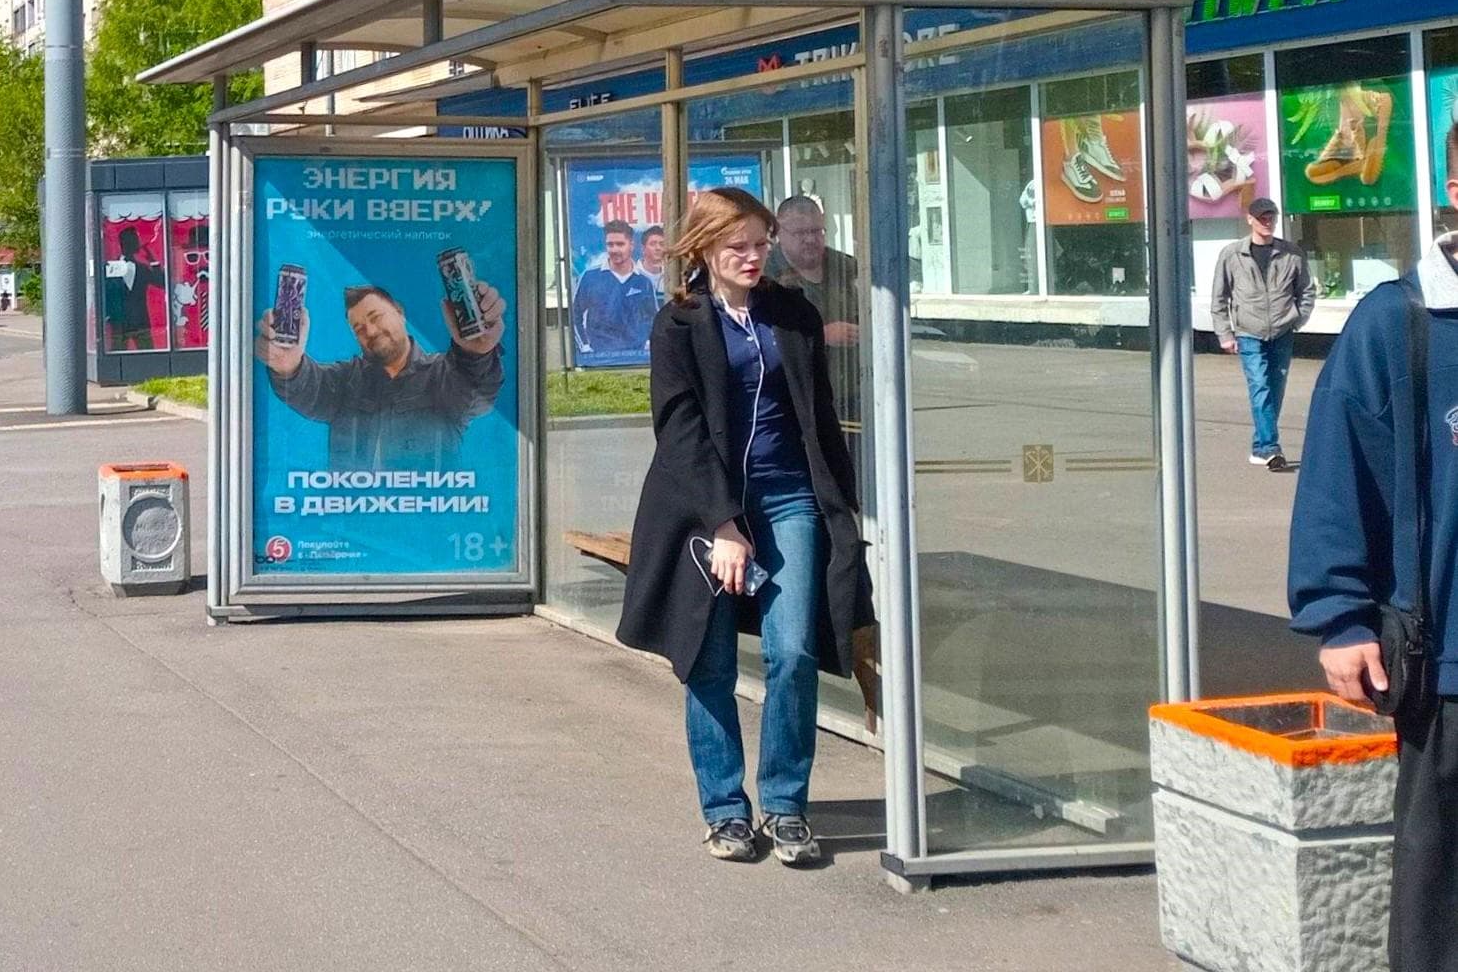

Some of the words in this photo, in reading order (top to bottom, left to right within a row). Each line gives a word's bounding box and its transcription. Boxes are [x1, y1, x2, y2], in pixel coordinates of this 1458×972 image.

[302, 167, 457, 191] ЭНЕРГИЯ
[266, 197, 354, 220] РУКИ
[367, 198, 493, 222] ВВЕРХ!
[599, 192, 639, 225] THE
[404, 229, 454, 241] напиток
[287, 471, 476, 489] ПОКОЛЕНИЯ
[274, 496, 295, 514] В
[300, 495, 490, 516] ДВИЖЕНИИ!
